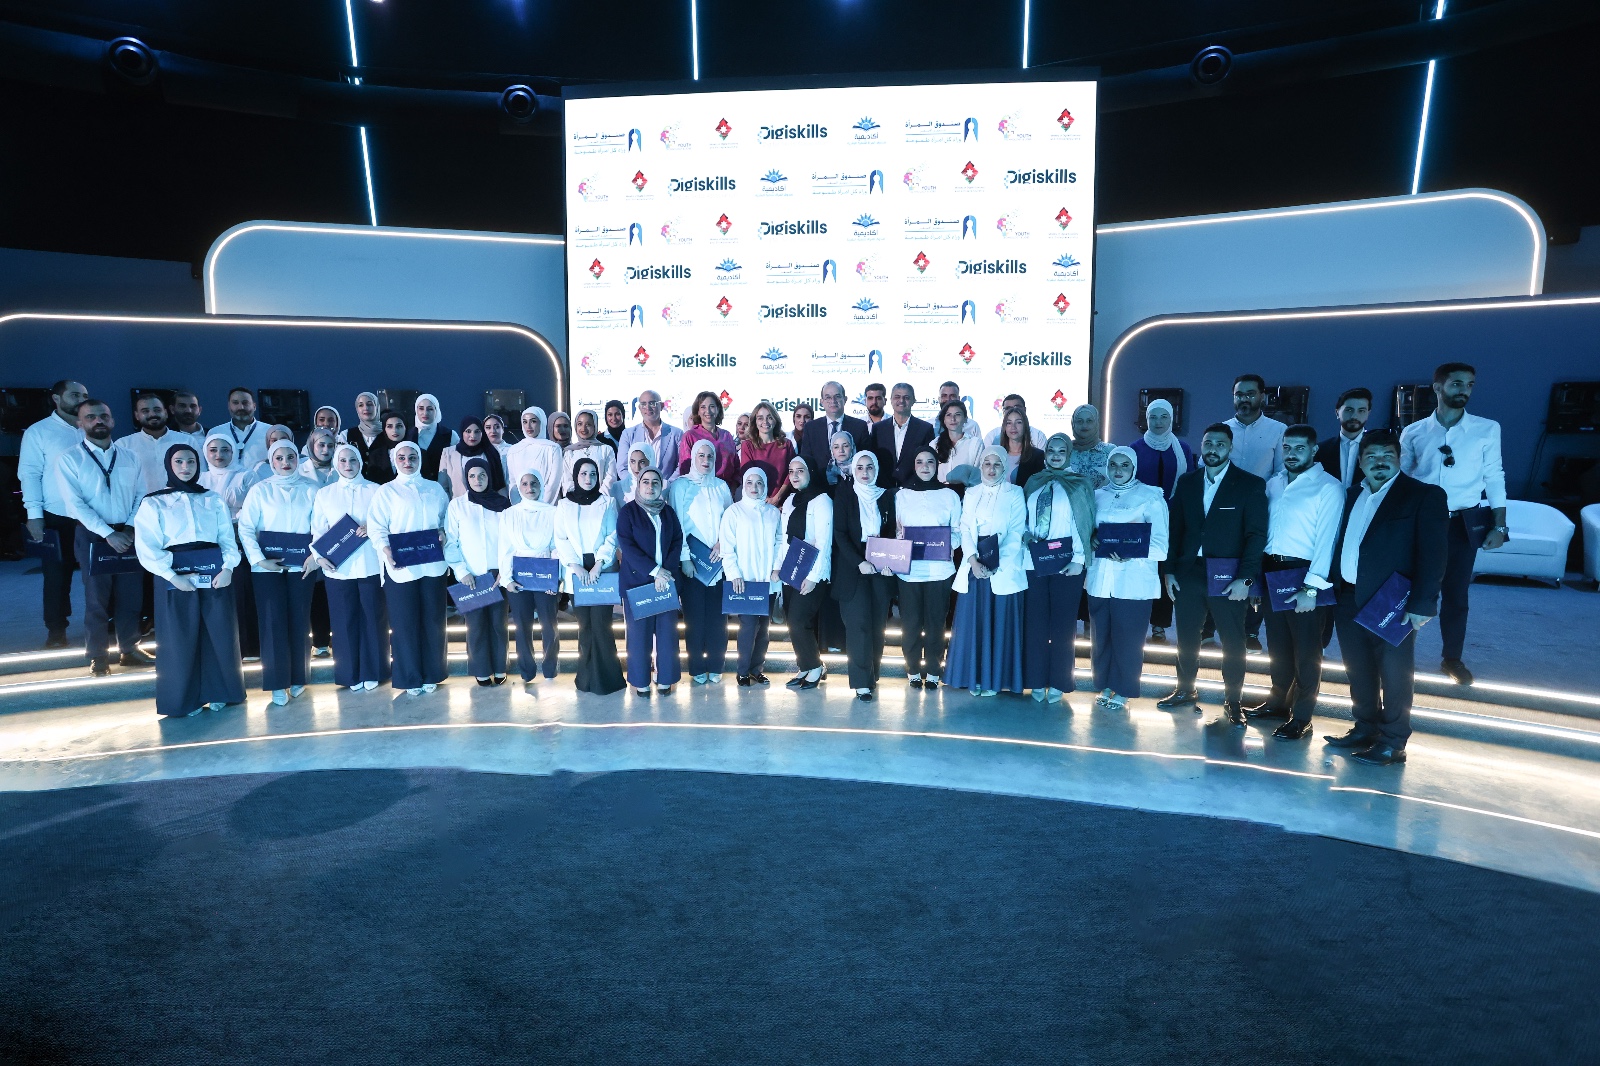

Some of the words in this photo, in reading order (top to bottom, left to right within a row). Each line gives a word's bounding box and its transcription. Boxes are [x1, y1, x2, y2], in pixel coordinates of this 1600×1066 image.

[757, 124, 828, 141] Digiskills
[668, 176, 737, 195] Digiskills
[1004, 168, 1077, 187] Digiskills
[758, 219, 828, 238] Digiskills
[624, 264, 692, 281] Digiskills
[956, 258, 1027, 277] Digiskills
[758, 303, 828, 321] Digiskills
[670, 352, 737, 370] Digiskills
[1001, 351, 1072, 368] Digiskills
